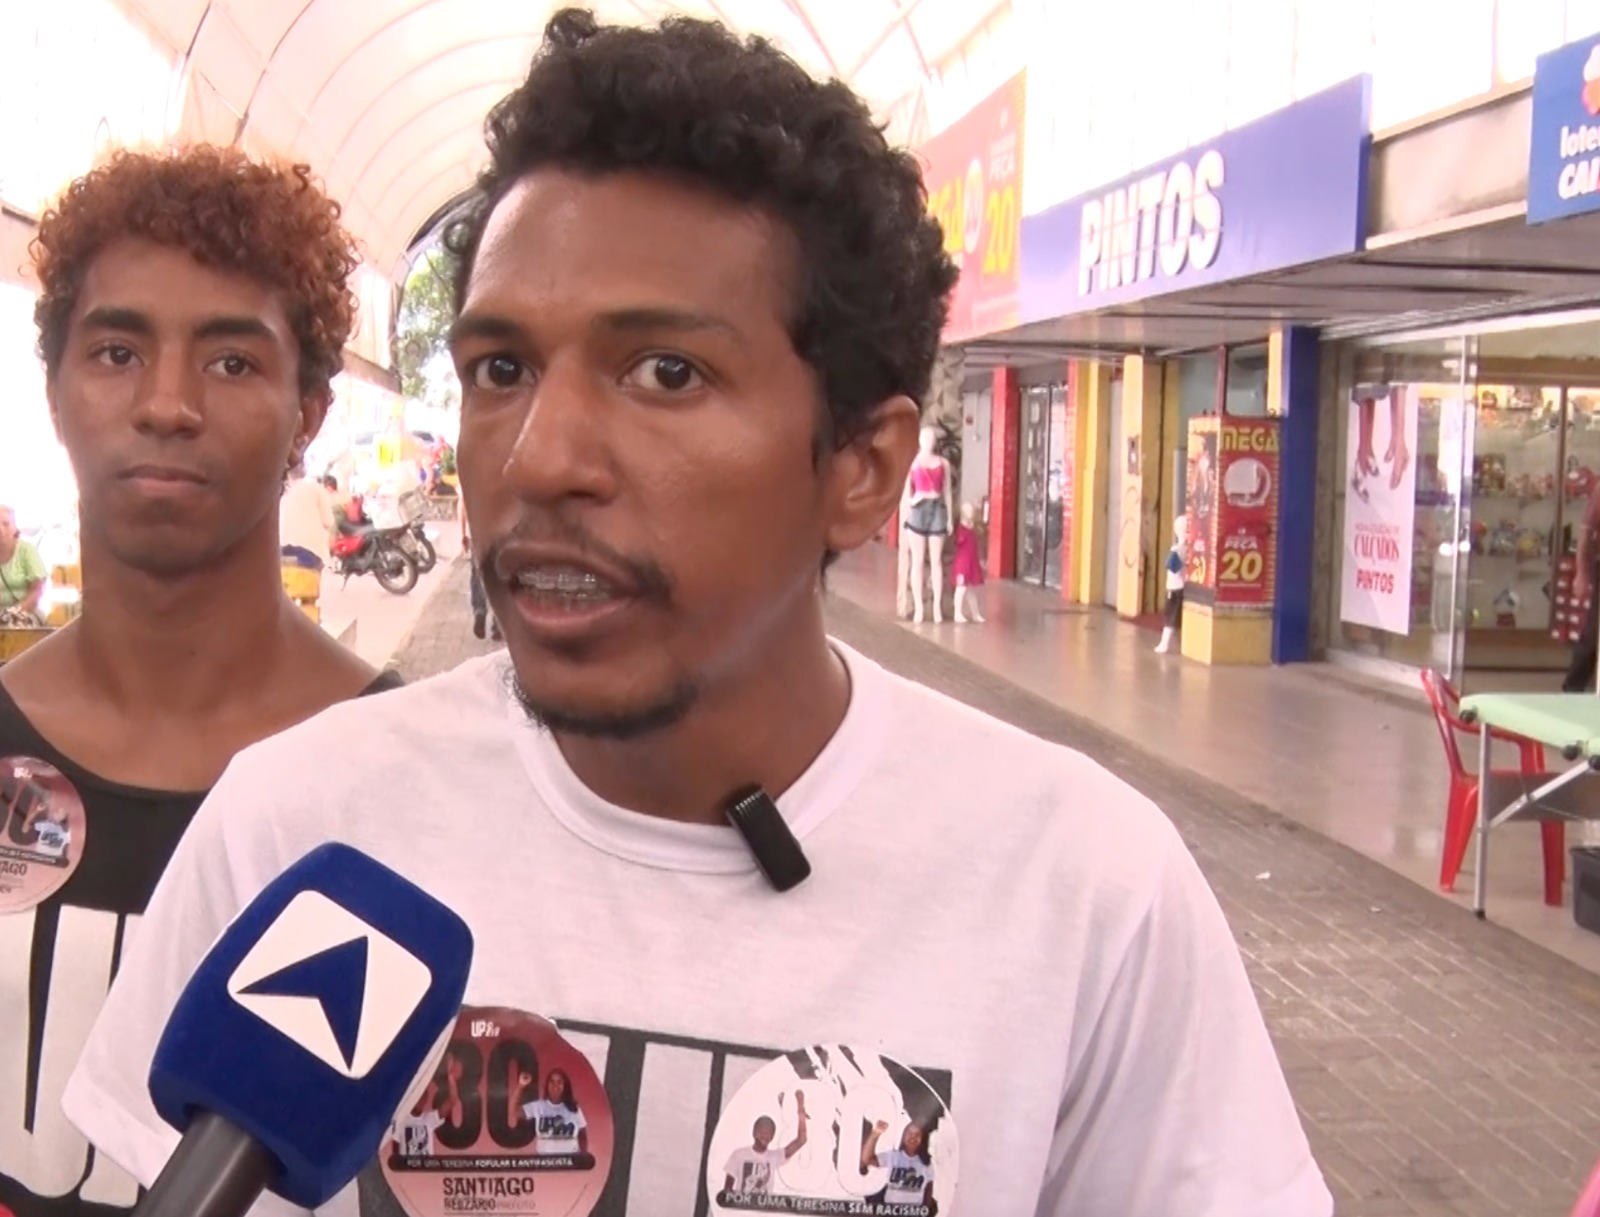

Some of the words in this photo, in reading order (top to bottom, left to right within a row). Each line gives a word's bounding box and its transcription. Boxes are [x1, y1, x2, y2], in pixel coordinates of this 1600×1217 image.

[1560, 124, 1600, 159] lote
[984, 187, 1015, 274] 20
[1078, 150, 1225, 297] PINTOS
[1221, 425, 1279, 451] MEGA
[1219, 550, 1263, 582] 20
[1356, 568, 1394, 594] PINTOS
[442, 1177, 535, 1197] SANTIAGO
[757, 1194, 788, 1208] UMA
[790, 1197, 847, 1213] TERESINA
[848, 1202, 875, 1215] SEM
[875, 1203, 931, 1217] RACISMO
